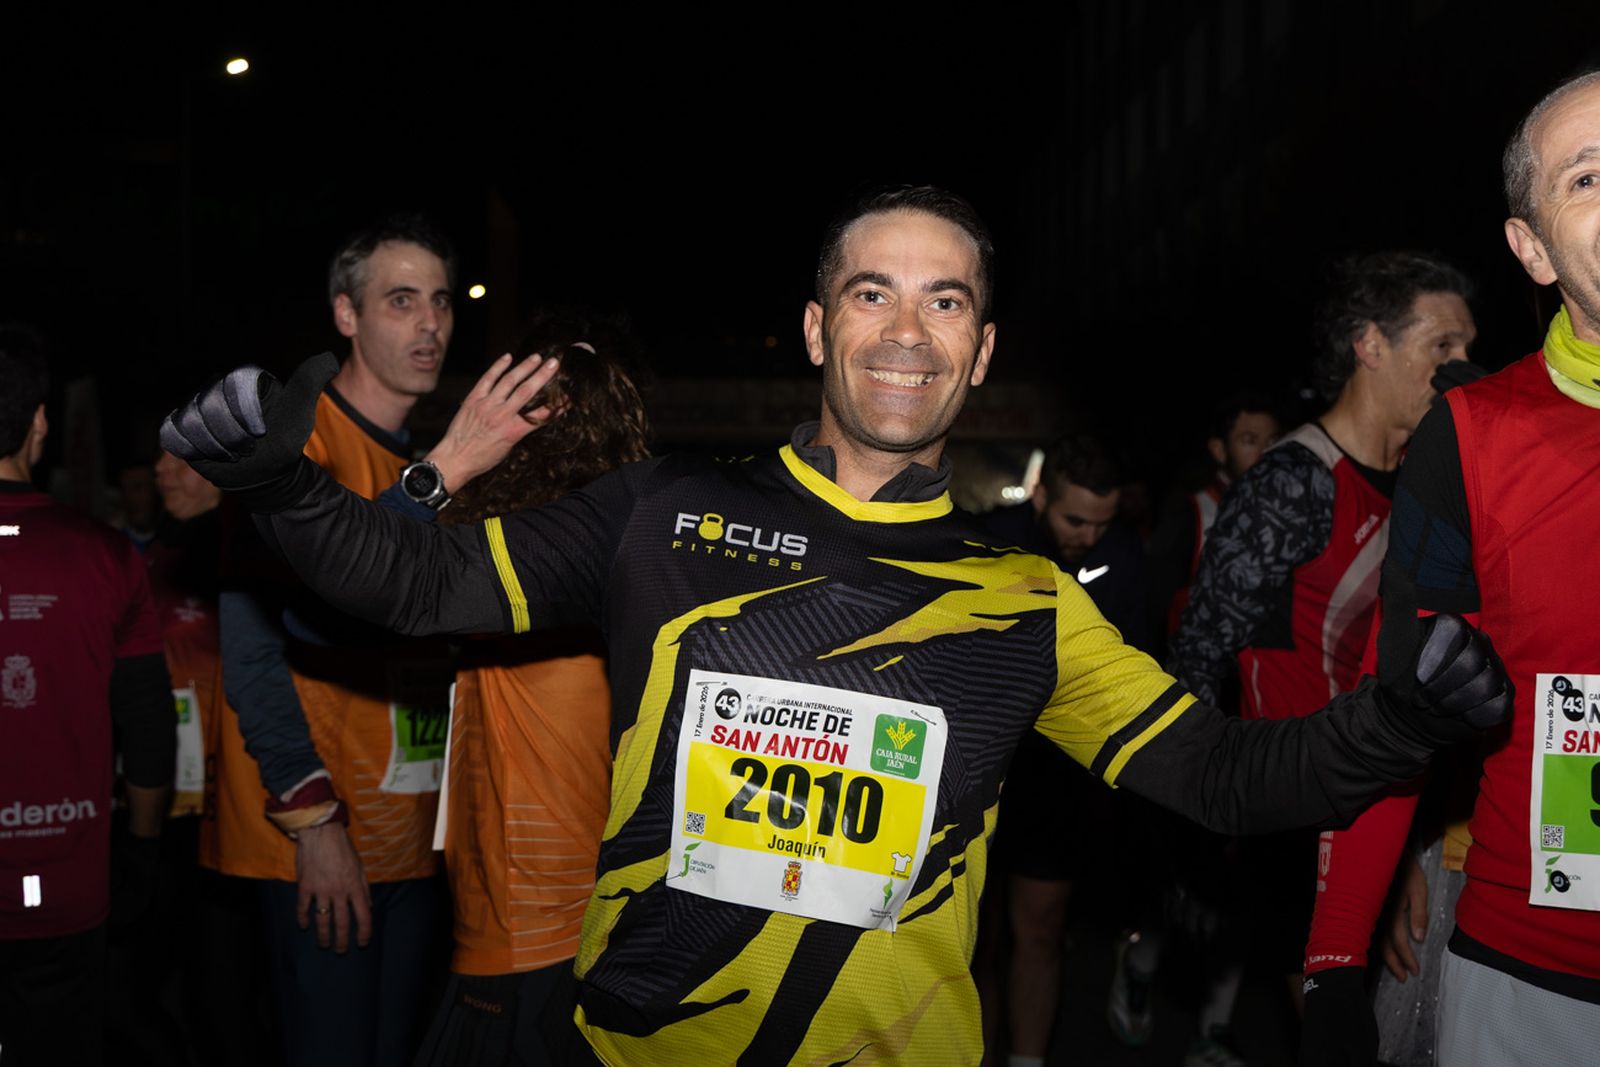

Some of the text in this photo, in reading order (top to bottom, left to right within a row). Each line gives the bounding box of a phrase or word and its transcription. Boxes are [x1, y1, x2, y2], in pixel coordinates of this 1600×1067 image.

[672, 540, 802, 571] FITNESS
[716, 695, 739, 713] 43
[776, 698, 803, 707] URBANA
[804, 701, 853, 716] INTERNACIONAL
[1563, 696, 1584, 713] 43
[743, 703, 853, 736] NOCHE DE
[1547, 710, 1554, 718] de
[406, 708, 448, 747] 122
[694, 729, 701, 737] 17
[710, 724, 849, 765] SAN ANTÓN
[1545, 741, 1552, 749] 17
[894, 752, 917, 764] RURAL
[724, 757, 884, 844] 2010
[767, 834, 827, 861] Joaquín
